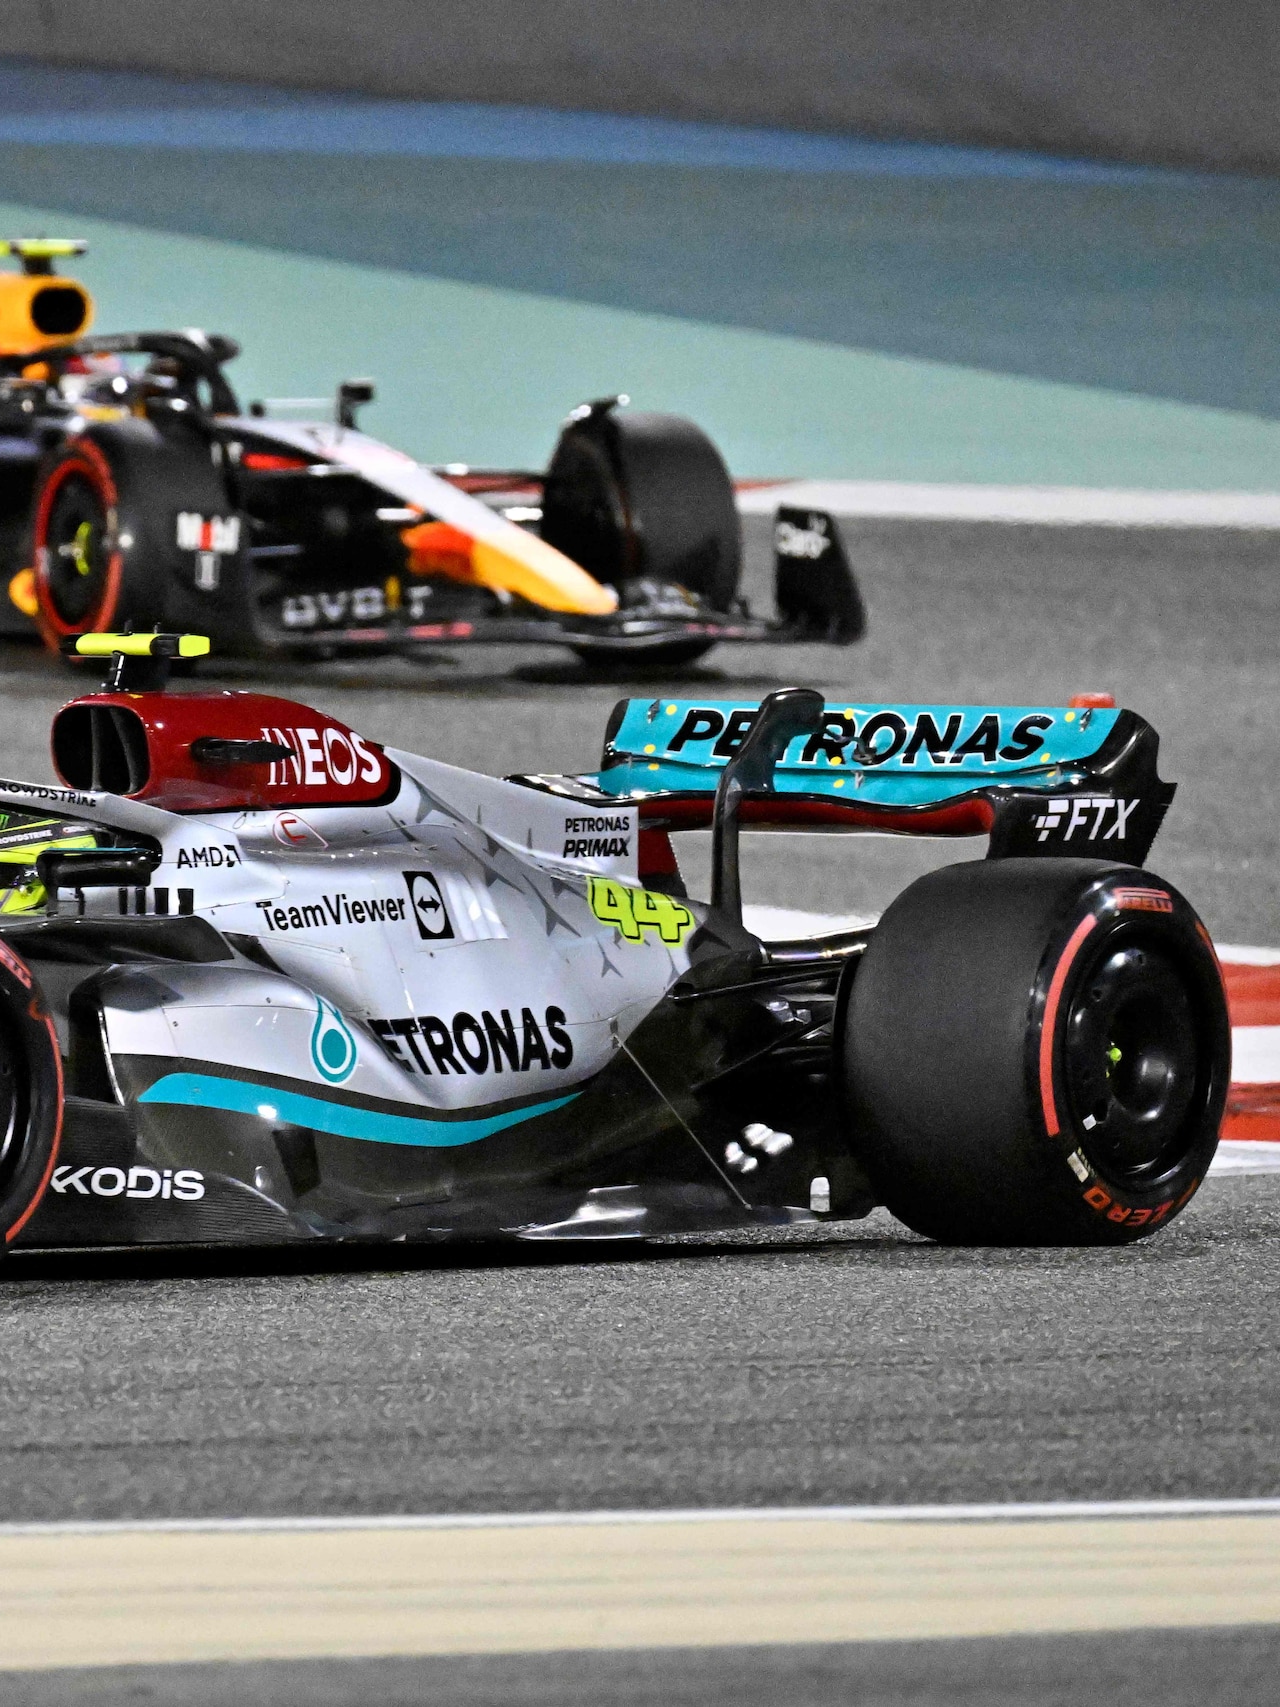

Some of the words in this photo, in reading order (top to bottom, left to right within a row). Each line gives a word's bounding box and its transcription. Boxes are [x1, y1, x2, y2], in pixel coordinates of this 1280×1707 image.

[260, 727, 381, 786] INEOS
[666, 708, 1054, 767] PERONAS
[565, 816, 630, 833] PETRONAS
[1064, 799, 1140, 842] FTX
[177, 845, 223, 869] AMD
[563, 836, 631, 858] PRIMAX
[256, 893, 405, 931] TeamViewer
[588, 876, 694, 945] 44
[366, 1005, 573, 1075] ETRONAS
